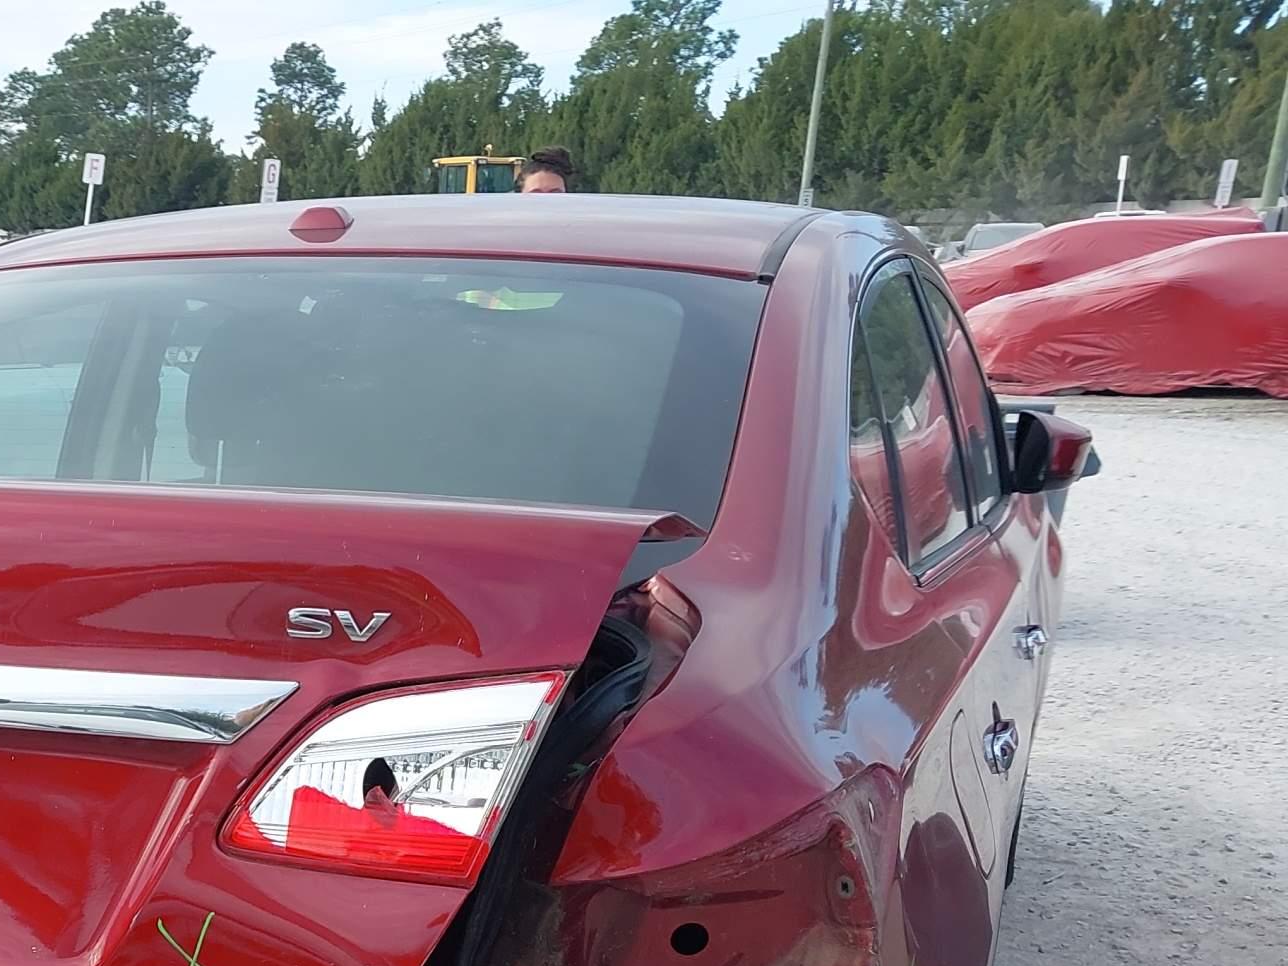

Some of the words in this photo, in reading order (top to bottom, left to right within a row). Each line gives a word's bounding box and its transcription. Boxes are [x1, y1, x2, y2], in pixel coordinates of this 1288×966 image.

[88, 158, 101, 178] F
[266, 163, 277, 184] G
[286, 607, 392, 641] SV
